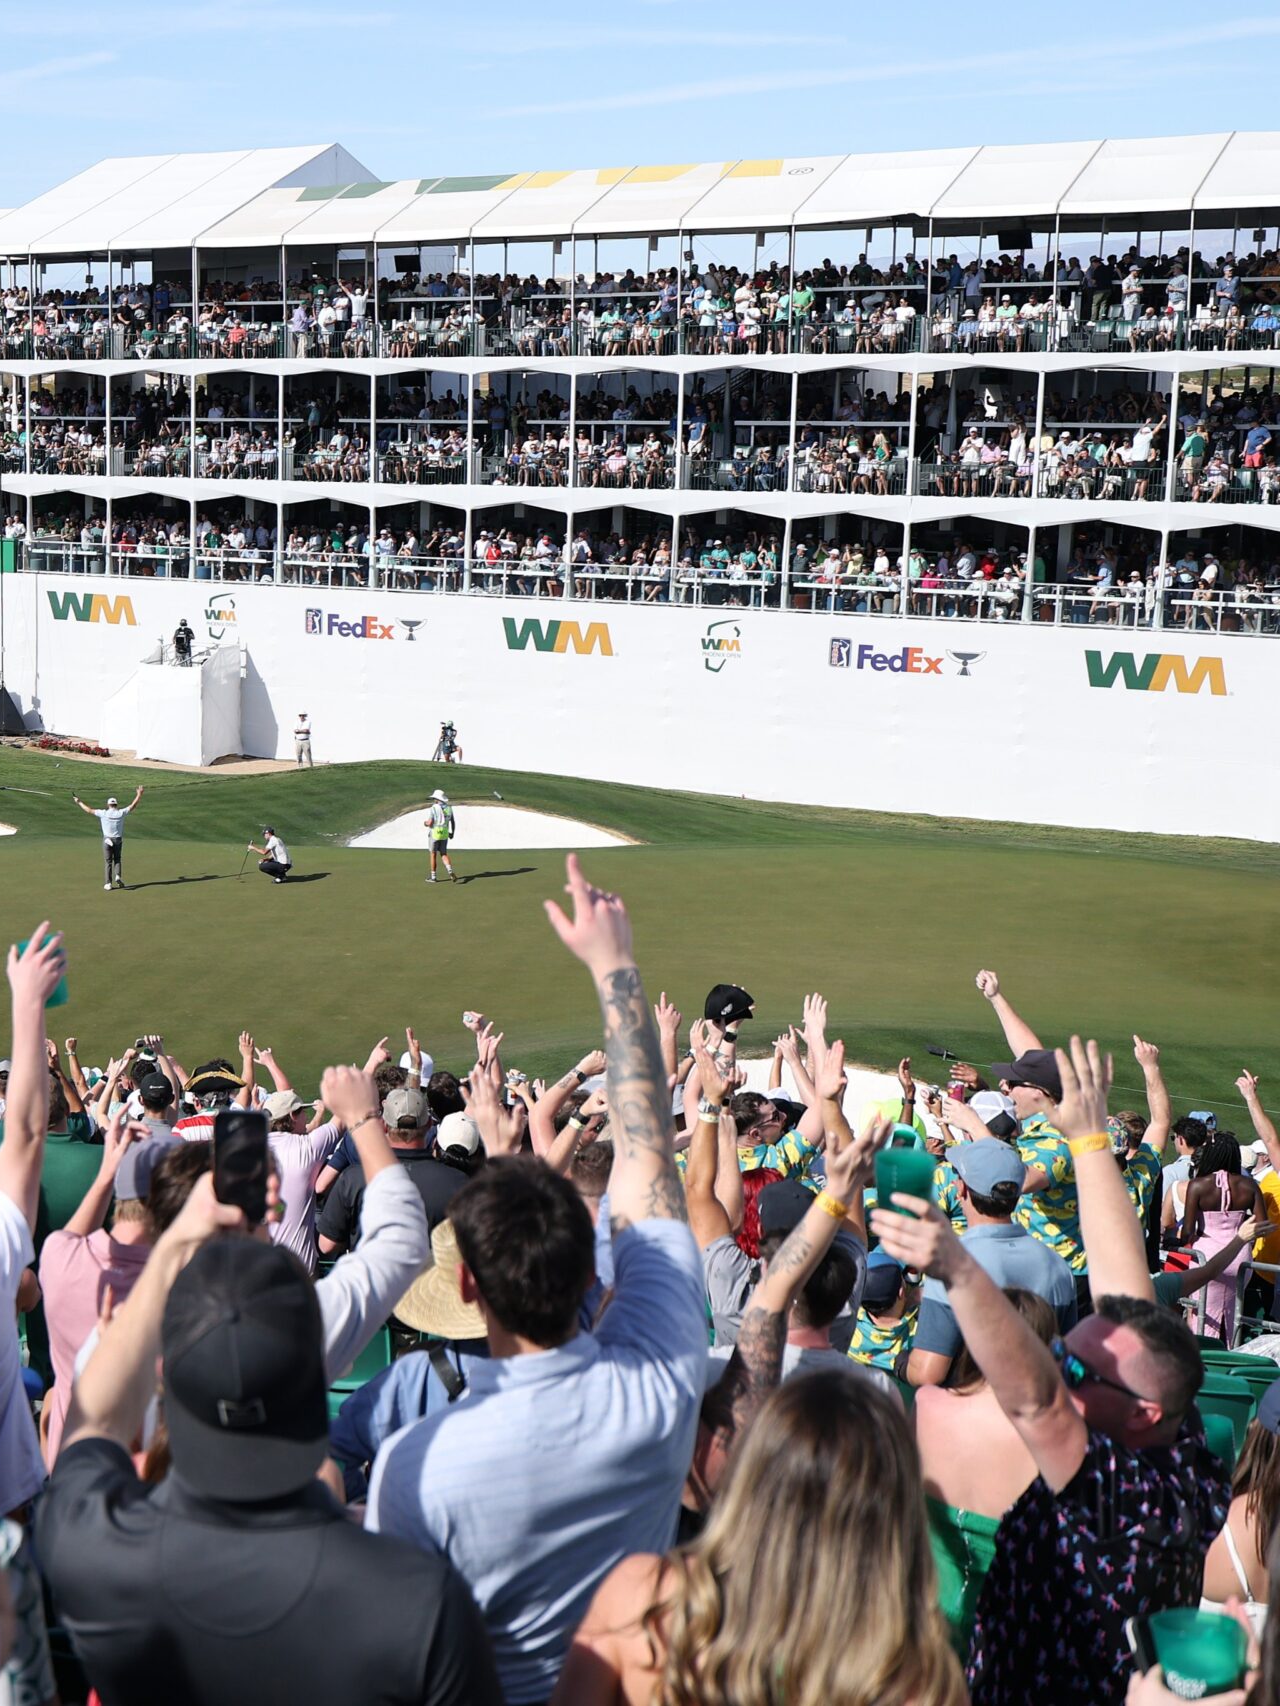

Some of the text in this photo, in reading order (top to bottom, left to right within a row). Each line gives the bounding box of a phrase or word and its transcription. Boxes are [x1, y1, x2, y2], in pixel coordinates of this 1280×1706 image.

[46, 590, 138, 626] WM
[204, 609, 237, 622] WM
[327, 613, 395, 640] FedEx
[502, 617, 614, 657] WM
[701, 638, 741, 652] WM
[856, 644, 944, 675] FedEx
[1084, 649, 1228, 697] WM
